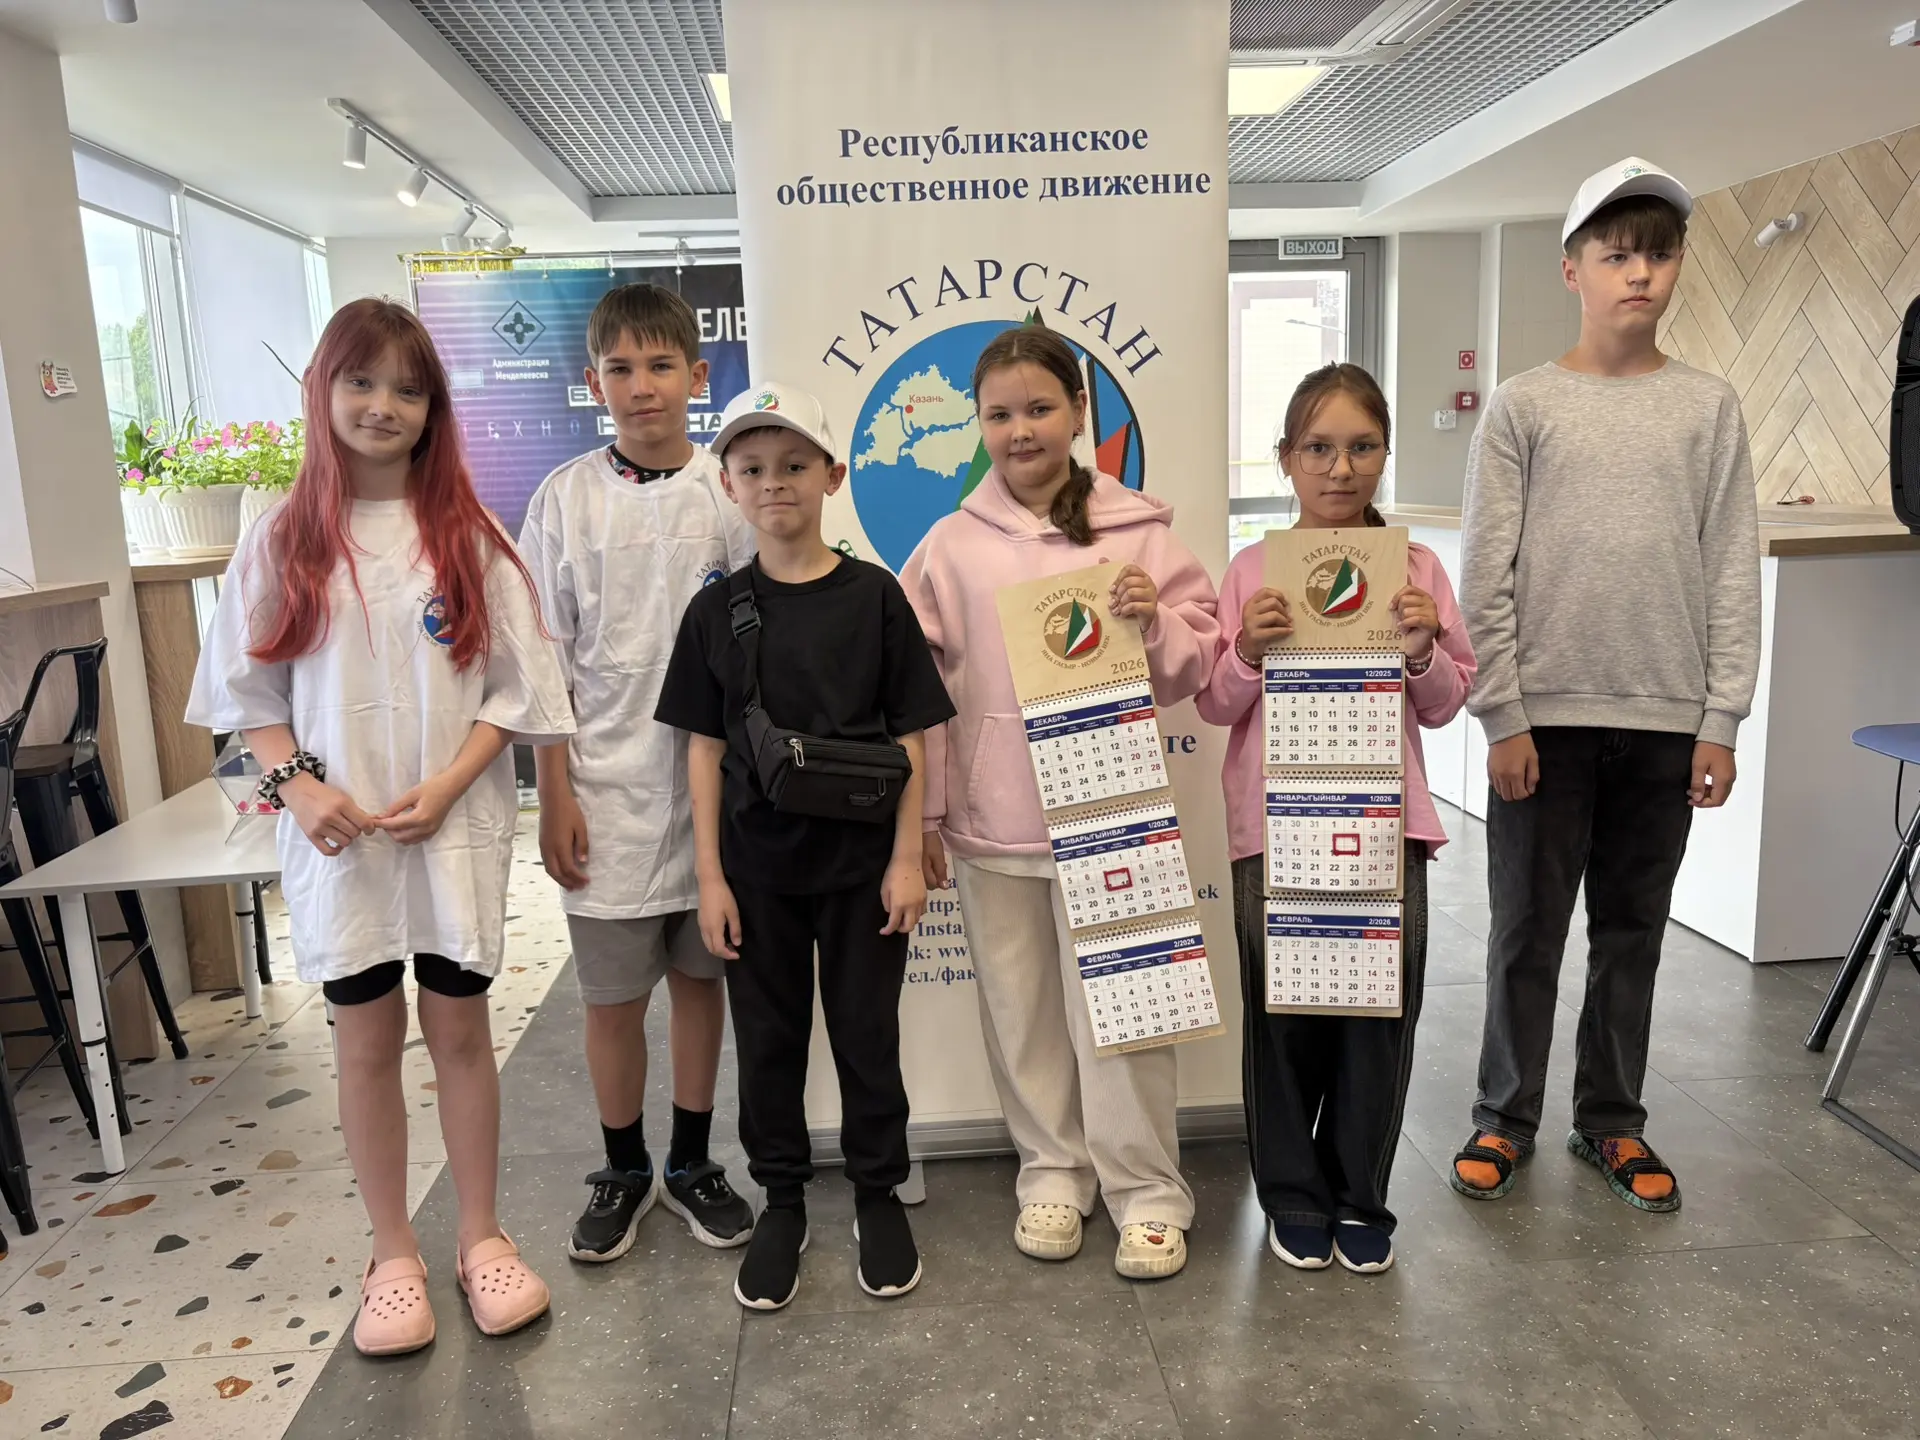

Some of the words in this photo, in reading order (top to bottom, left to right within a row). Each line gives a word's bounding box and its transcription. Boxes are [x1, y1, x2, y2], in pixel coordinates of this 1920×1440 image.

[838, 126, 1149, 163] Республиканское
[776, 174, 1030, 208] общественное
[1039, 169, 1212, 202] движение
[1286, 240, 1337, 254] ВЫХОД
[696, 307, 747, 343] ЕЛЕ
[821, 258, 1164, 377] ТАТАРСТАН
[492, 359, 550, 368] Администрация
[908, 393, 944, 404] Казань
[1302, 544, 1371, 564] ТАТАРСТАН
[1034, 588, 1098, 614] ТАТАРСТАН
[1367, 630, 1402, 641] 2026
[1110, 657, 1145, 675] 2026
[1273, 671, 1311, 679] ДЕКАБРЬ
[1033, 715, 1068, 728] ДЕКАБРЬ
[1118, 698, 1144, 709] 12/2025
[1289, 724, 1300, 733] 16
[1328, 724, 1338, 732] 18
[1348, 724, 1358, 732] 19
[1366, 724, 1378, 732] 20
[1385, 724, 1395, 732] 21
[1073, 750, 1084, 758] 10
[1110, 742, 1120, 750] 12
[1128, 739, 1138, 747] 13
[1146, 736, 1156, 744] 14
[1040, 770, 1051, 779] 15
[1059, 766, 1069, 775] 16
[1076, 763, 1085, 771] 17
[1094, 759, 1104, 768] 18
[1113, 756, 1123, 764] 19
[1130, 752, 1141, 761] 20
[1148, 749, 1158, 758] 21
[1270, 753, 1280, 761] 29
[1289, 753, 1299, 761] 30
[1308, 753, 1318, 762] 31
[1043, 784, 1053, 793] 22
[1061, 780, 1072, 789] 23
[1079, 777, 1089, 786] 24
[1096, 773, 1107, 782] 25
[1115, 770, 1126, 778] 26
[1133, 766, 1143, 775] 27
[1150, 763, 1161, 772] 28
[1046, 798, 1057, 806] 29
[1064, 794, 1074, 803] 30
[1081, 791, 1092, 799] 31
[1369, 795, 1392, 803] 1/2026
[1147, 819, 1169, 830] 1/2026
[1276, 915, 1313, 924] ФЕВРАЛЬ
[1368, 918, 1392, 926] 2/2026
[917, 921, 968, 938] Insta
[938, 946, 968, 958] ww
[1086, 952, 1122, 965] ФЕВРАЛЬ
[1173, 938, 1195, 949] 2/2026
[1291, 940, 1301, 948] 27
[1309, 940, 1320, 949] 28
[902, 966, 977, 985] тел./фак
